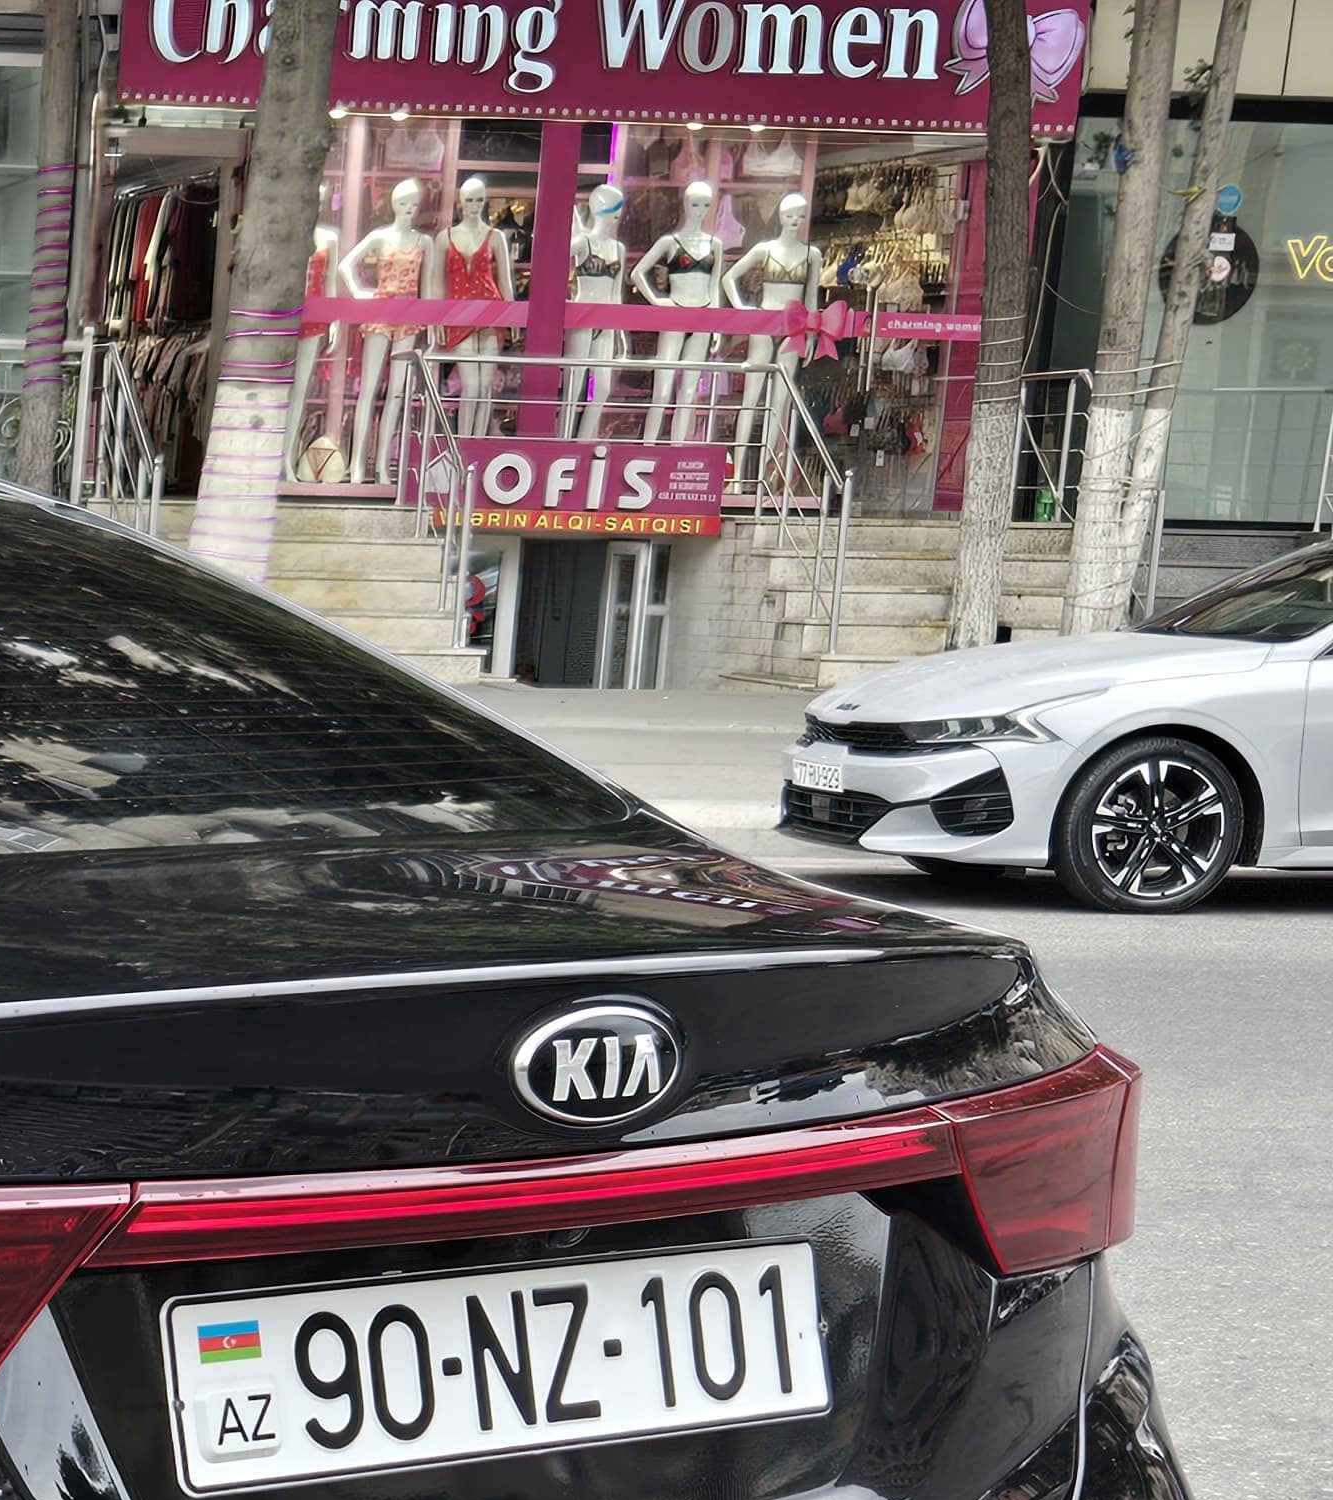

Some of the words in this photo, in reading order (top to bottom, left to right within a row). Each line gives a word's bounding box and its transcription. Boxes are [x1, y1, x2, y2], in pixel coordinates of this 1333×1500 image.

[151, 0, 559, 93] Chming
[599, 0, 940, 80] Women
[553, 1034, 661, 1102] KIA
[217, 1394, 276, 1446] AZ
[294, 1264, 793, 1450] 90-NZ-101
